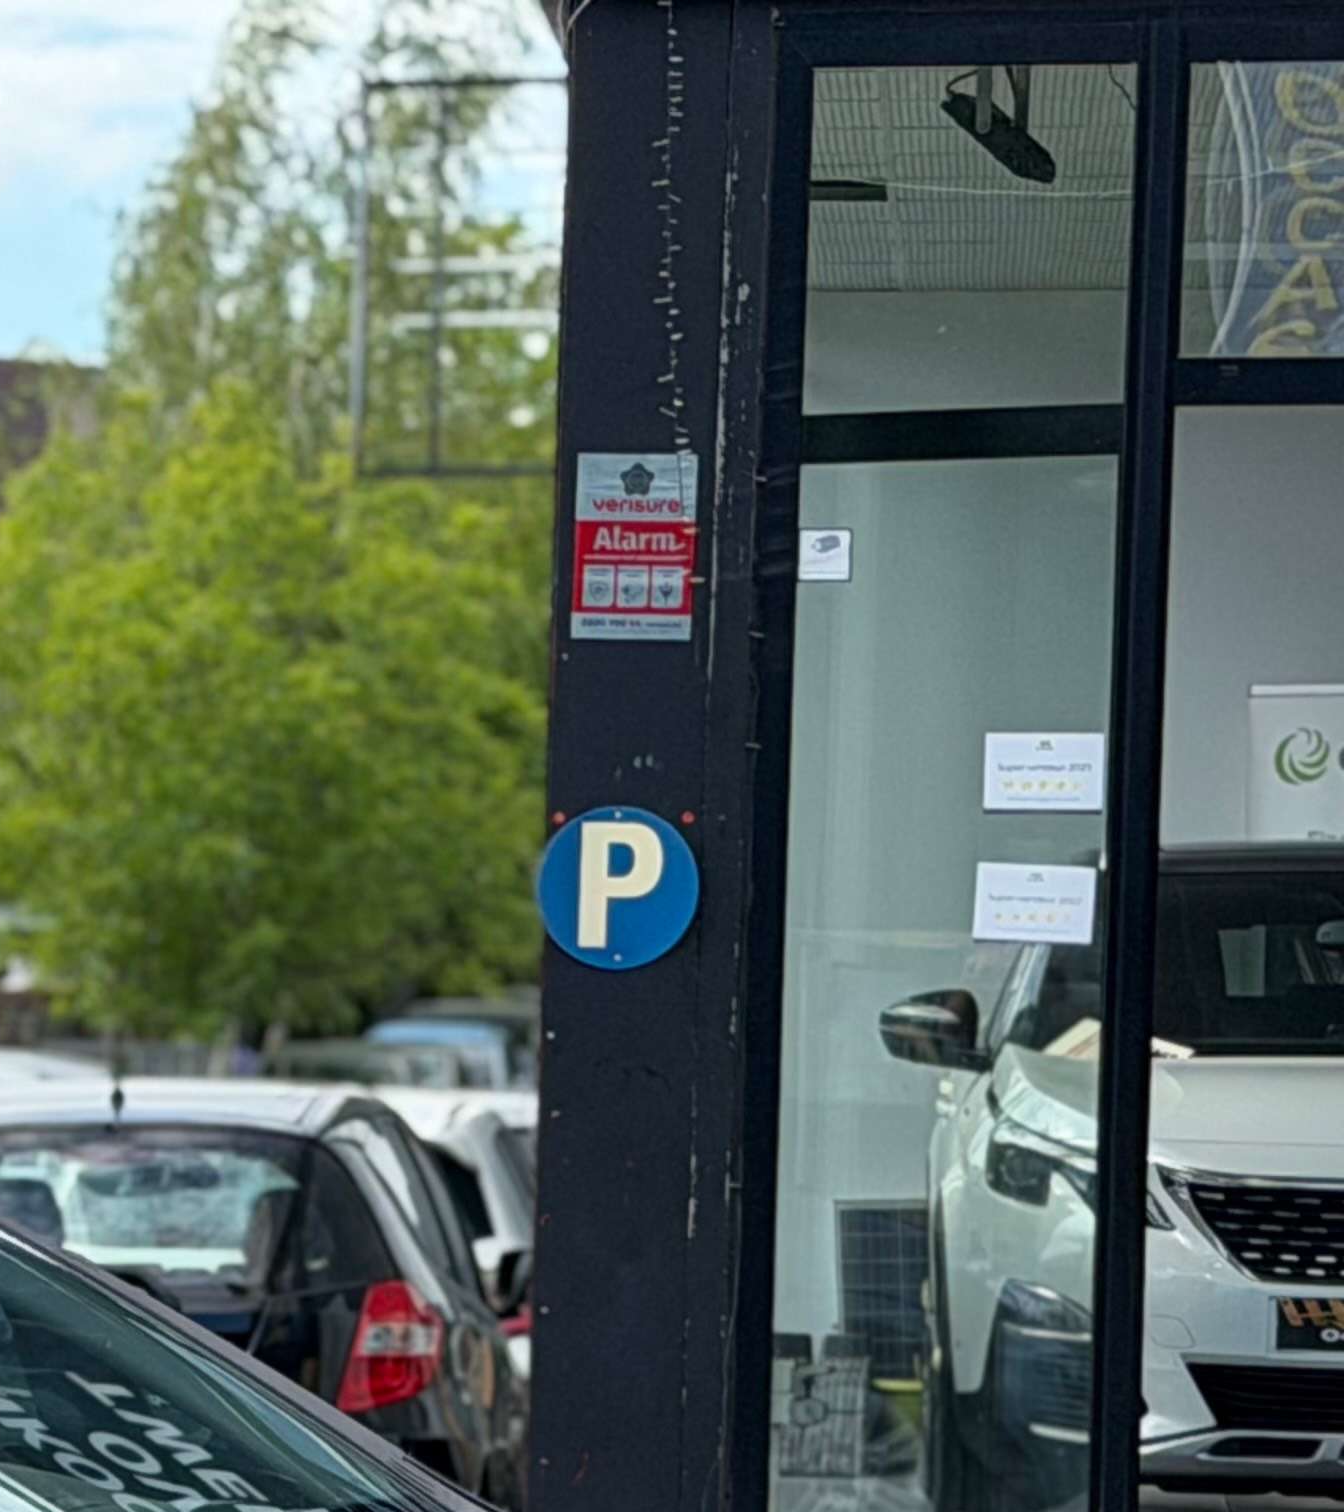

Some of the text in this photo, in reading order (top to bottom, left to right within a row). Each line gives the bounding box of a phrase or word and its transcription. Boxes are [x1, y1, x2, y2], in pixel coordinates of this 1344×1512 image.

[593, 498, 680, 513] verisure
[593, 526, 678, 552] Alarm
[577, 820, 664, 949] P
